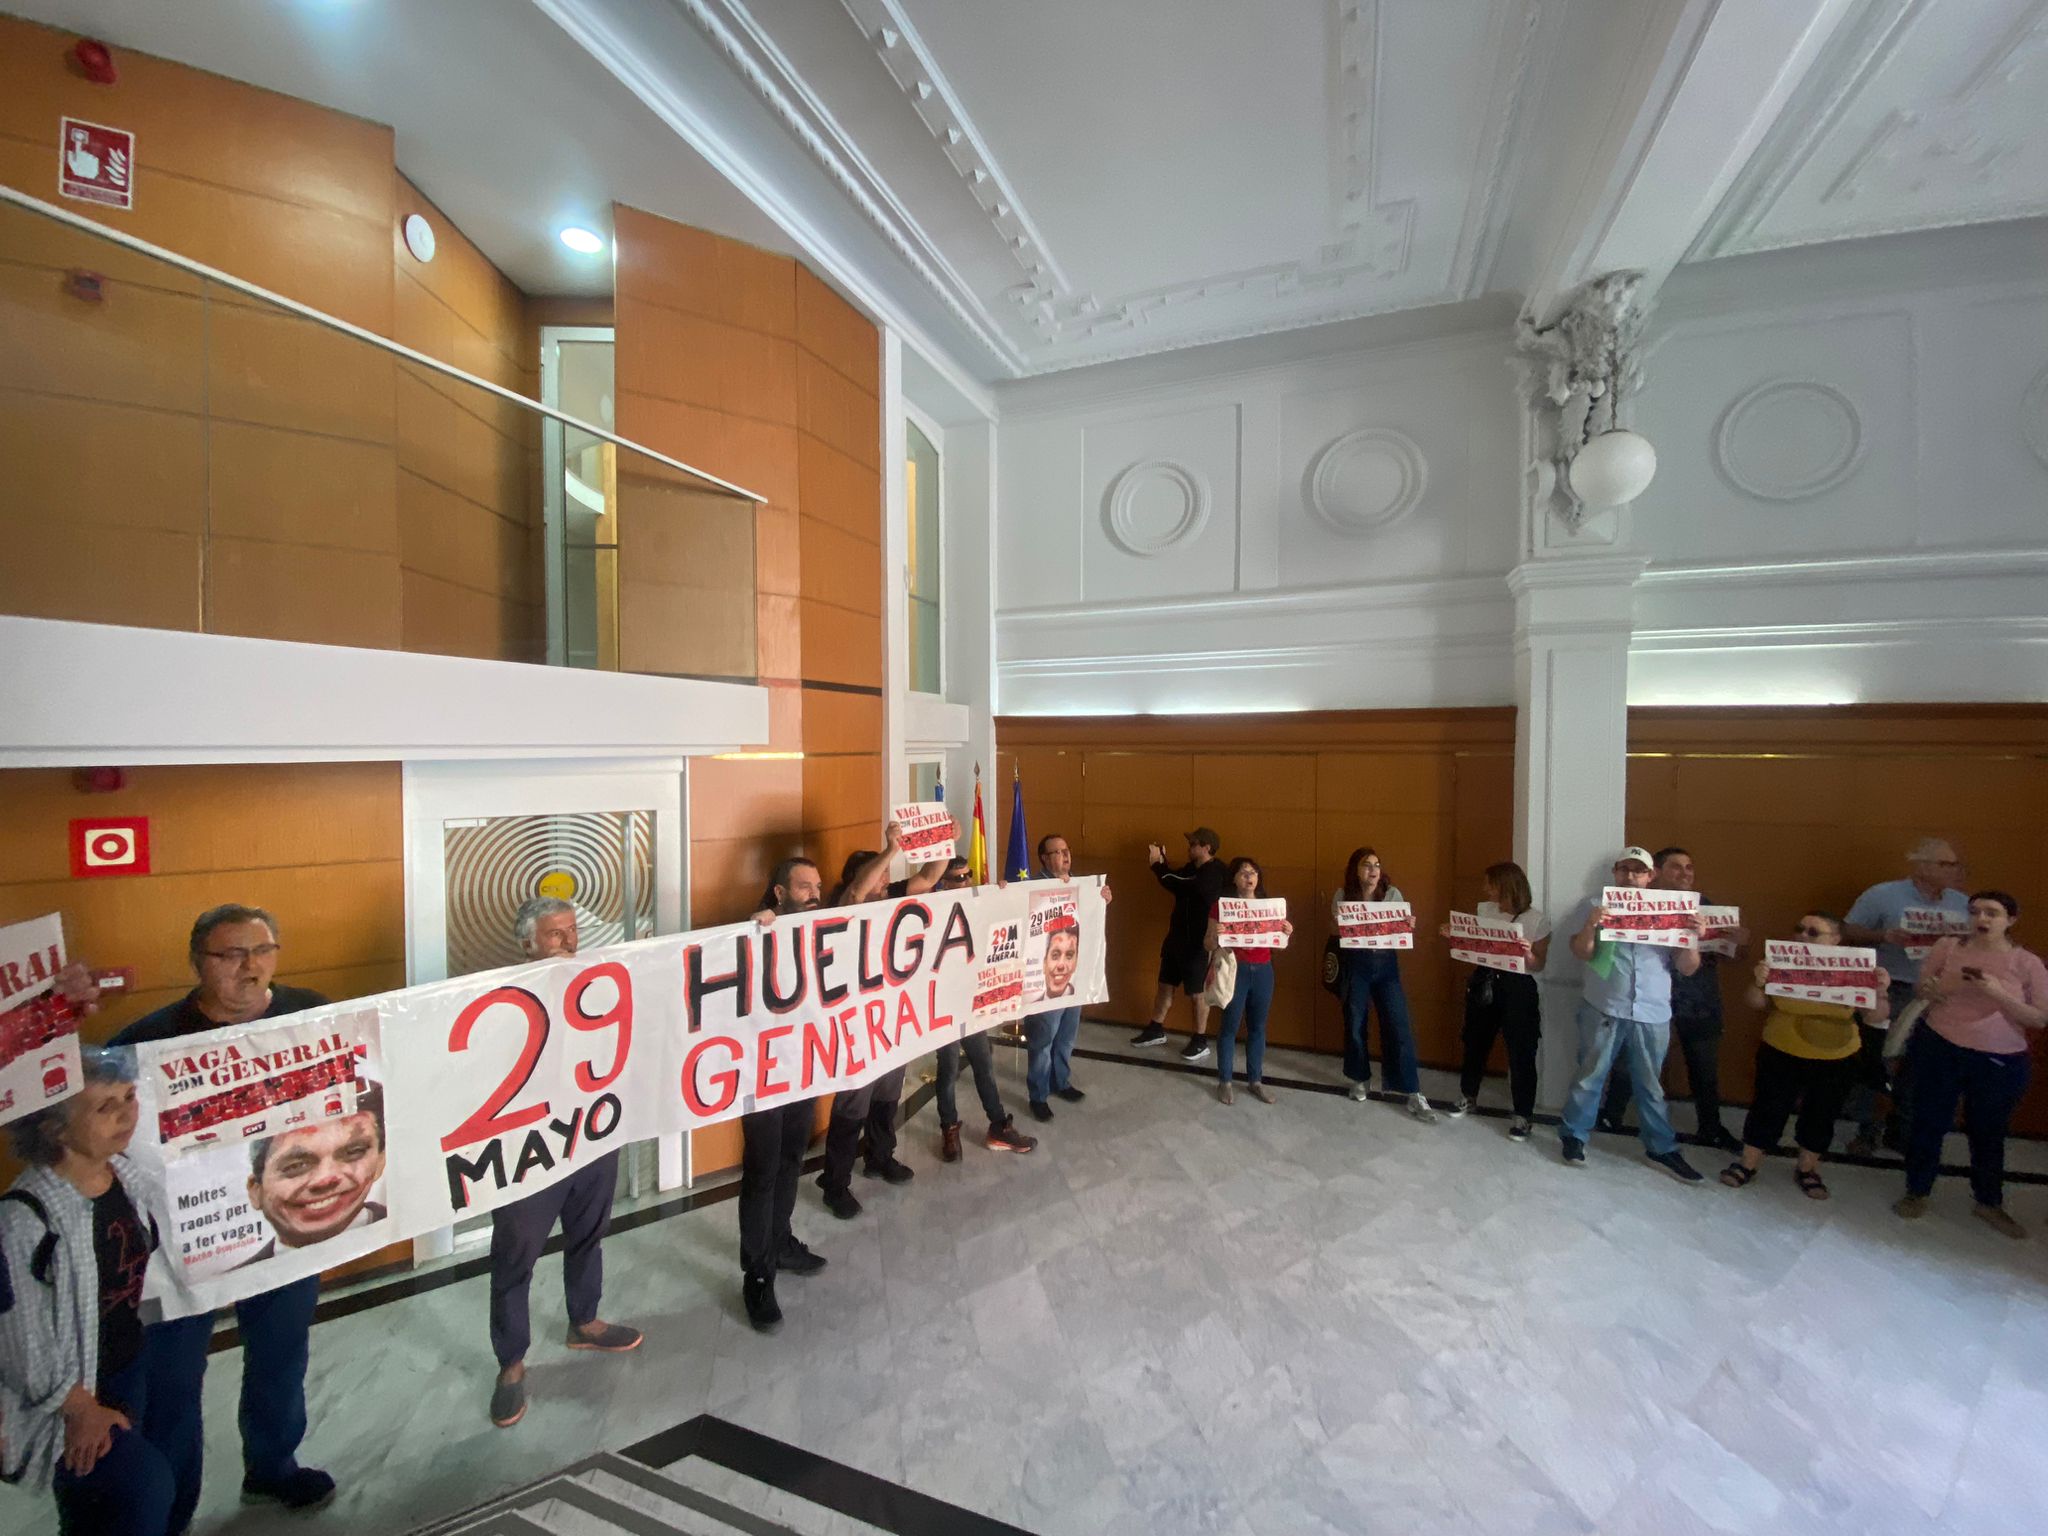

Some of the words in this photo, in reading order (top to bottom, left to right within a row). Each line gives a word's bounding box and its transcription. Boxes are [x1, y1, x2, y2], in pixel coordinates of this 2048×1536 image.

[895, 805, 921, 819] VAGA
[1605, 891, 1643, 901] VAGA
[1222, 901, 1249, 910] VAGA
[1339, 904, 1367, 914] VAGA
[1626, 900, 1697, 912] GENERAL
[1031, 912, 1043, 928] 29
[1044, 906, 1064, 921] VAGA
[1236, 908, 1285, 919] GENERAL
[1355, 909, 1410, 921] GENERAL
[1452, 915, 1479, 926] VAGA
[992, 924, 1018, 945] 29M
[1467, 926, 1519, 939] GENERAL
[993, 942, 1015, 955] VAGA
[1769, 944, 1811, 955] VAGA
[986, 950, 1019, 964] GENERAL
[1792, 956, 1874, 968] GENERAL
[683, 898, 976, 1033] HUELGA
[977, 967, 997, 980] VAGA
[986, 969, 1023, 987] GENERAL
[681, 980, 953, 1117] GENERAL
[160, 1045, 243, 1081] VAGA
[440, 961, 633, 1152] 29
[168, 1075, 204, 1096] 29M
[209, 1033, 349, 1087] GENERAL
[446, 1092, 621, 1213] MAYO
[178, 1186, 227, 1210] Moltes
[180, 1211, 220, 1232] raons
[226, 1203, 248, 1221] per
[183, 1242, 191, 1253] a
[196, 1234, 216, 1249] fer
